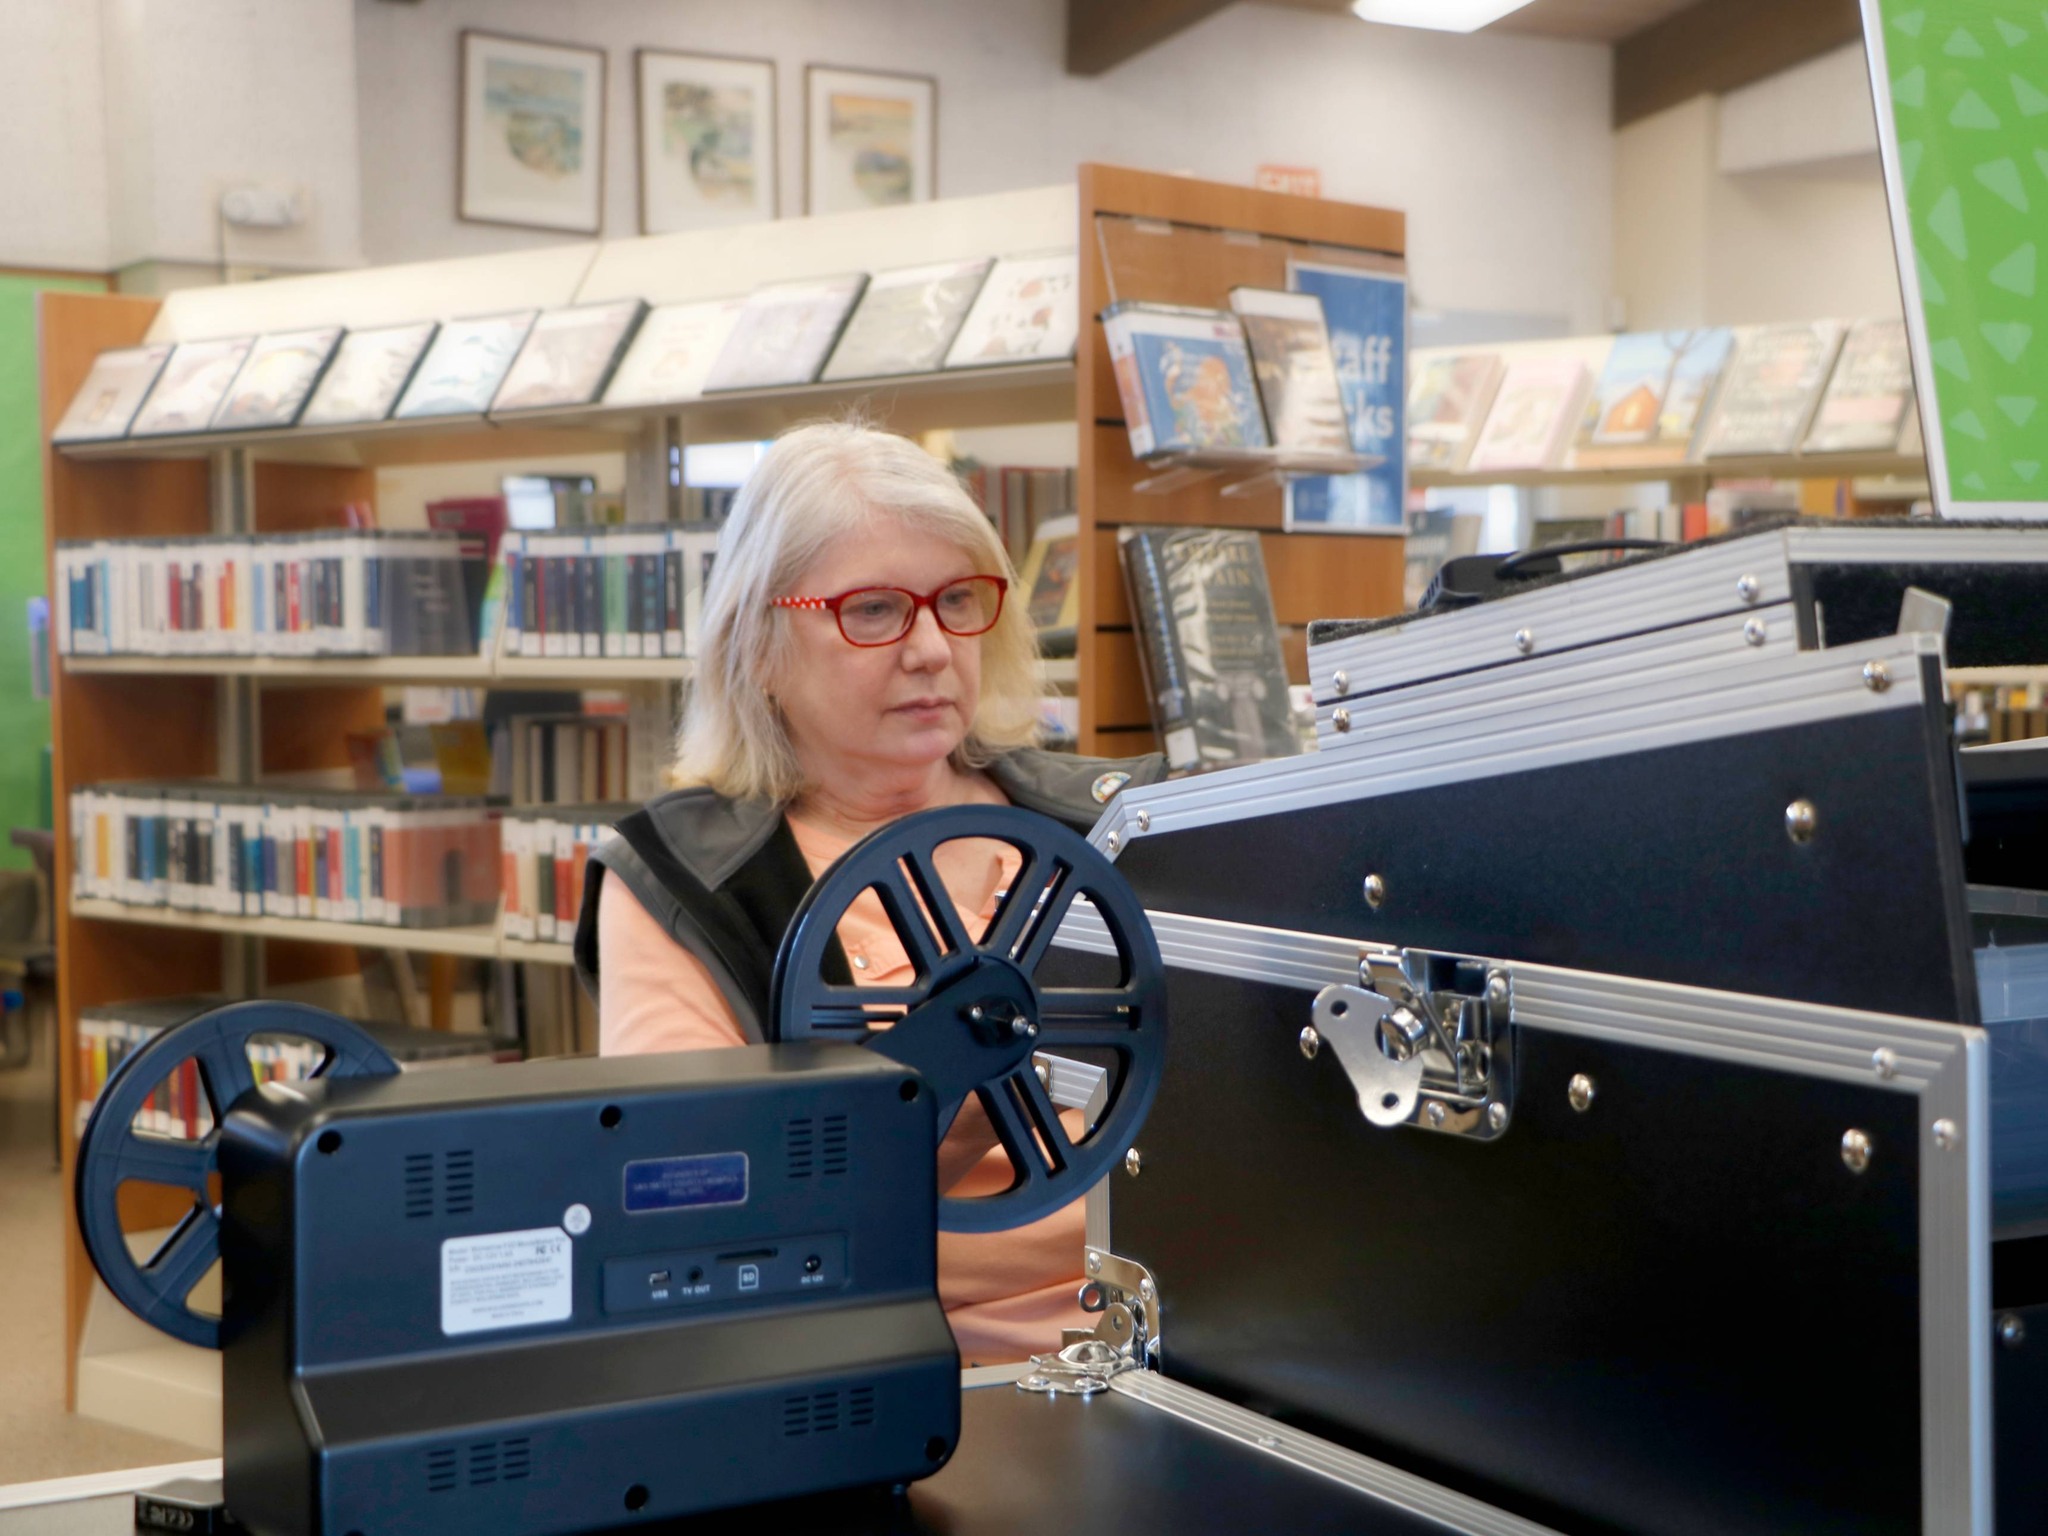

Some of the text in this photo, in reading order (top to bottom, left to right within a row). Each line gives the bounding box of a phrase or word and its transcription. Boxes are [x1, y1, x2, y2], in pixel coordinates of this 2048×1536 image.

[1333, 333, 1392, 384] aff
[743, 1273, 754, 1282] SD
[652, 1289, 668, 1298] USB
[682, 1284, 710, 1295] TV OUT
